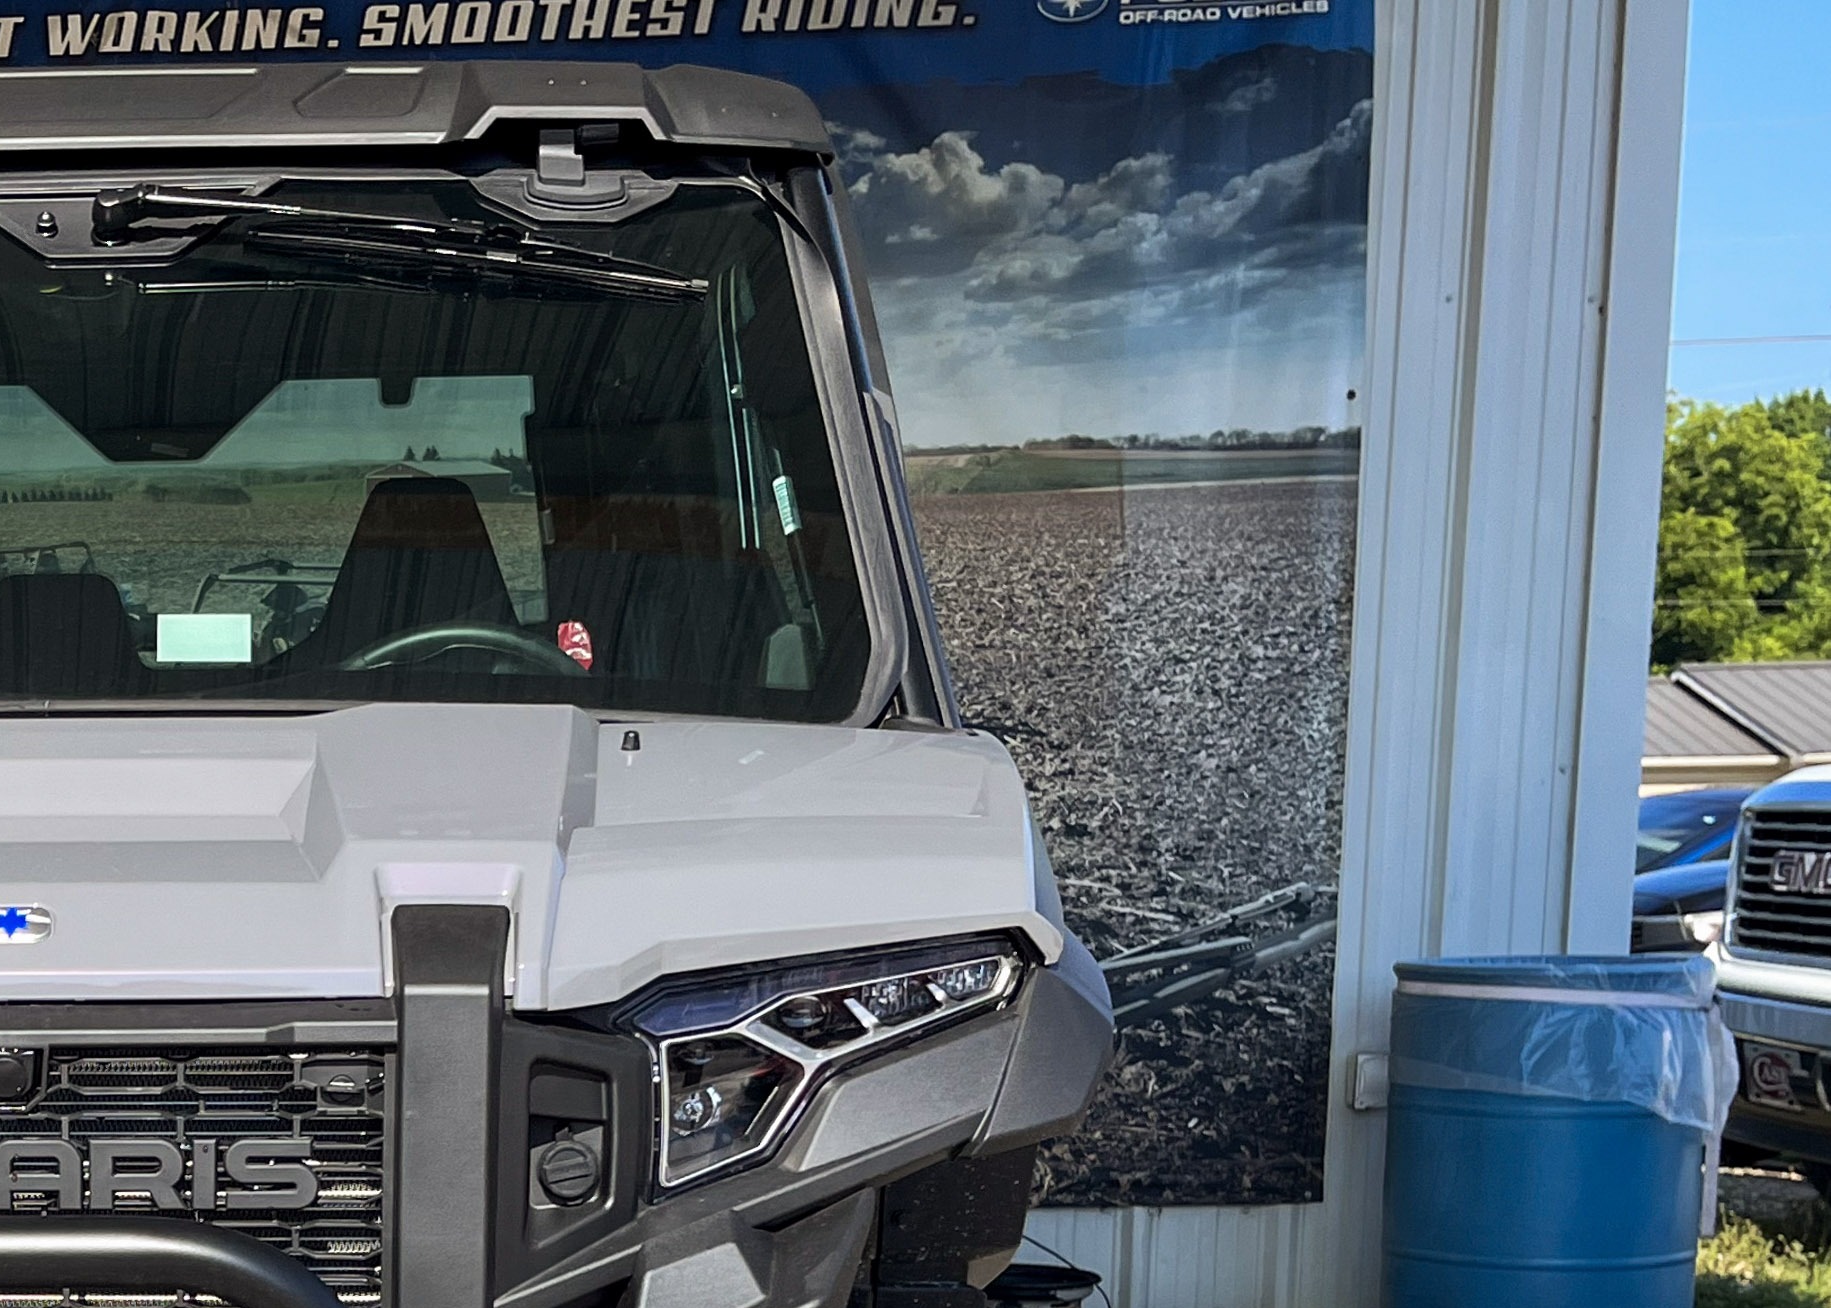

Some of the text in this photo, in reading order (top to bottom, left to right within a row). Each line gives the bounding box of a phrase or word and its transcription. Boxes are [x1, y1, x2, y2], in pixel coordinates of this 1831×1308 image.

[47, 8, 339, 56] WORKING.
[359, 0, 712, 47] SMOOTHEST
[742, 0, 975, 32] RIDING.
[1119, 0, 1329, 24] OFF-ROAD VEHICLES
